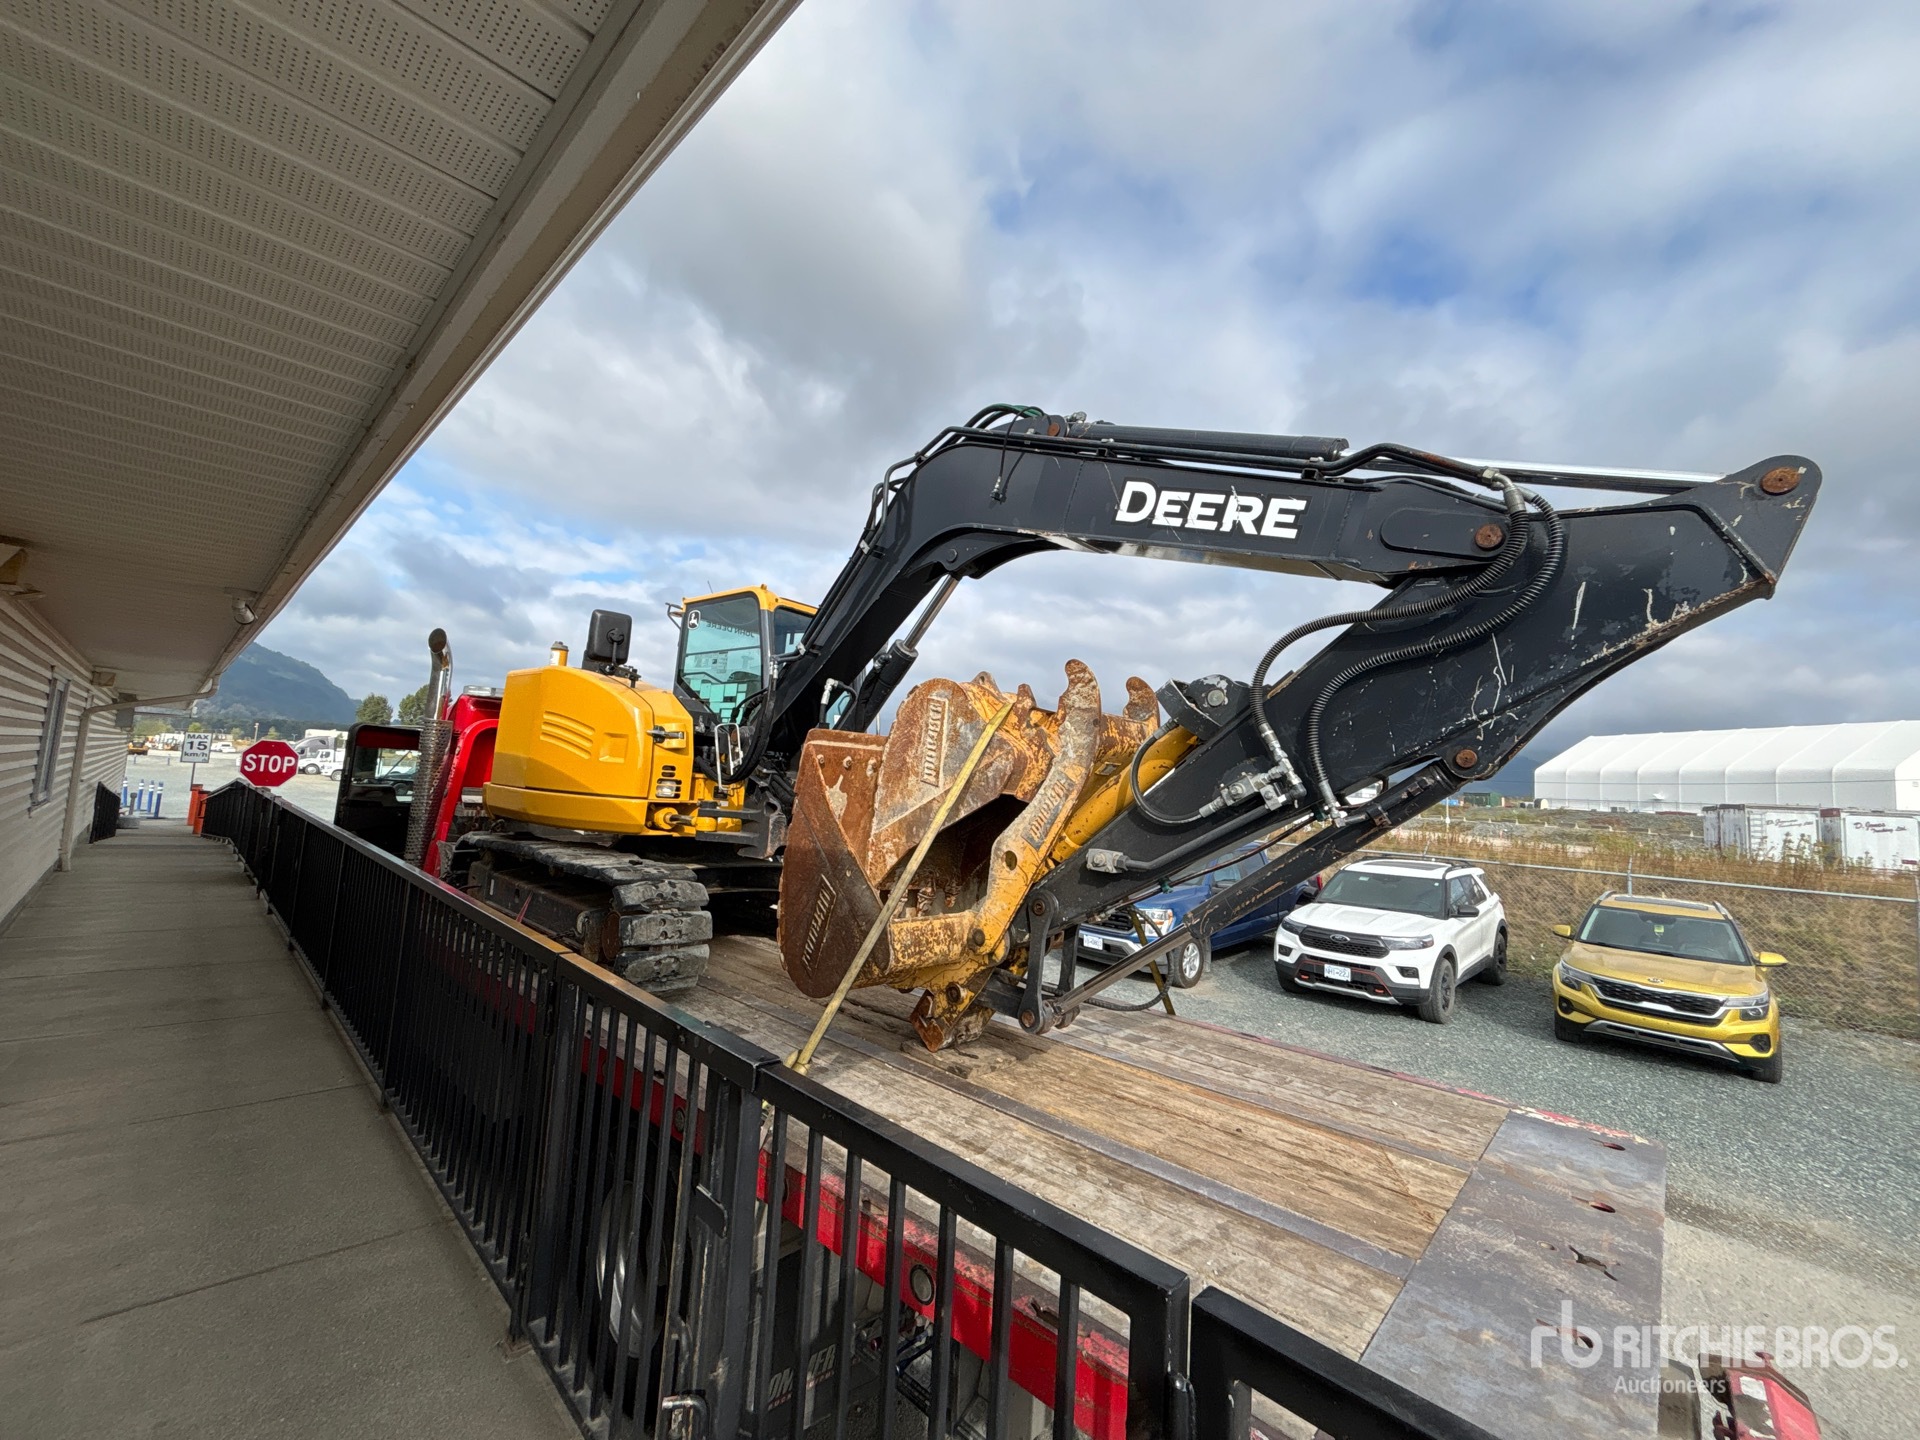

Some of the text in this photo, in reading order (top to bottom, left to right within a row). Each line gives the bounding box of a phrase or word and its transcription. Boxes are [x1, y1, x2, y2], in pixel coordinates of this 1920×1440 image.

[1115, 480, 1307, 539] DEERE
[186, 740, 208, 751] 15
[243, 753, 296, 773] STOP
